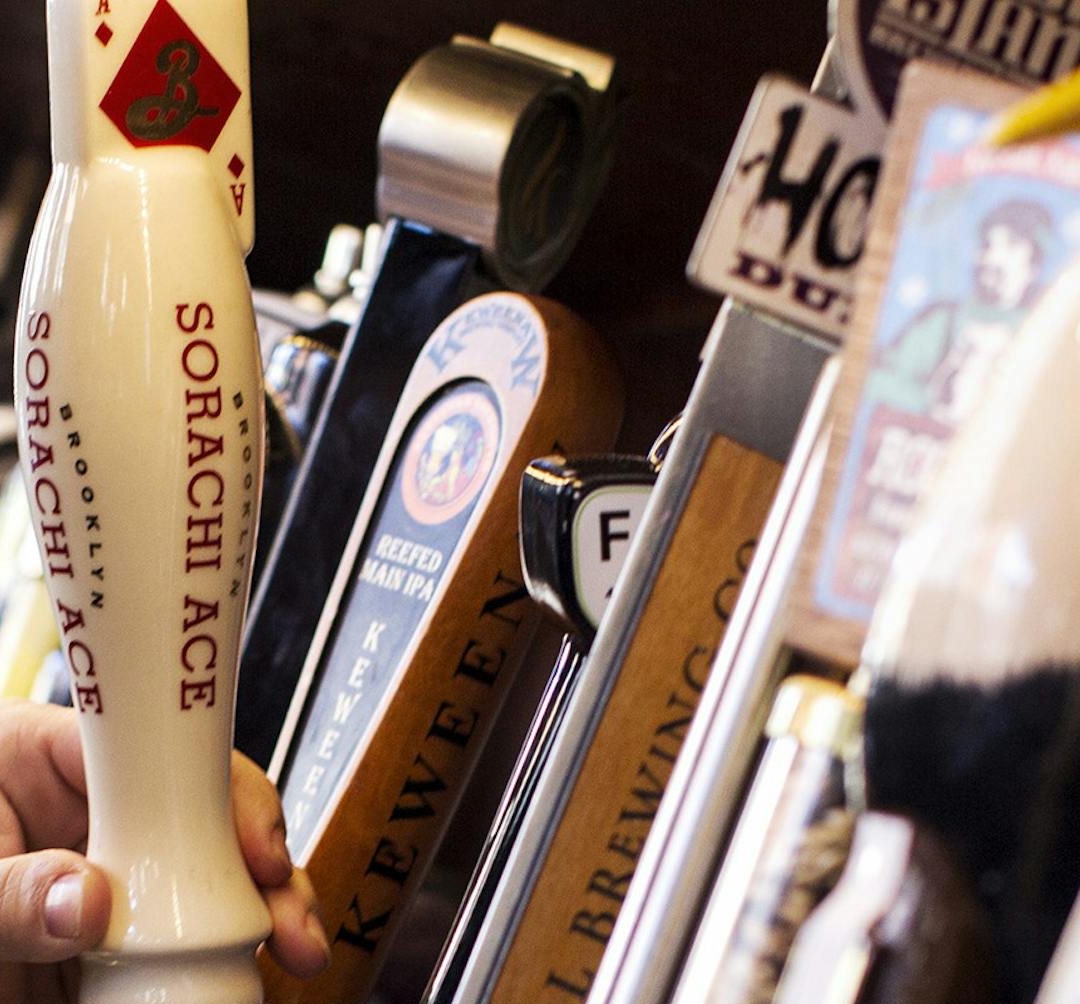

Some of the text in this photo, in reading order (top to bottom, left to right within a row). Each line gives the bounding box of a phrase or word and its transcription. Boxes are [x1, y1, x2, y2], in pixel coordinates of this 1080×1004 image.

[25, 311, 104, 715] SORACHI ACE
[59, 403, 104, 609] BROOKLYN
[176, 302, 225, 711] SORACHI ACE
[230, 392, 254, 597] BROOKLYN
[376, 534, 443, 573] REEFED
[403, 573, 434, 602] IPA
[332, 560, 526, 955] KEWEEN
